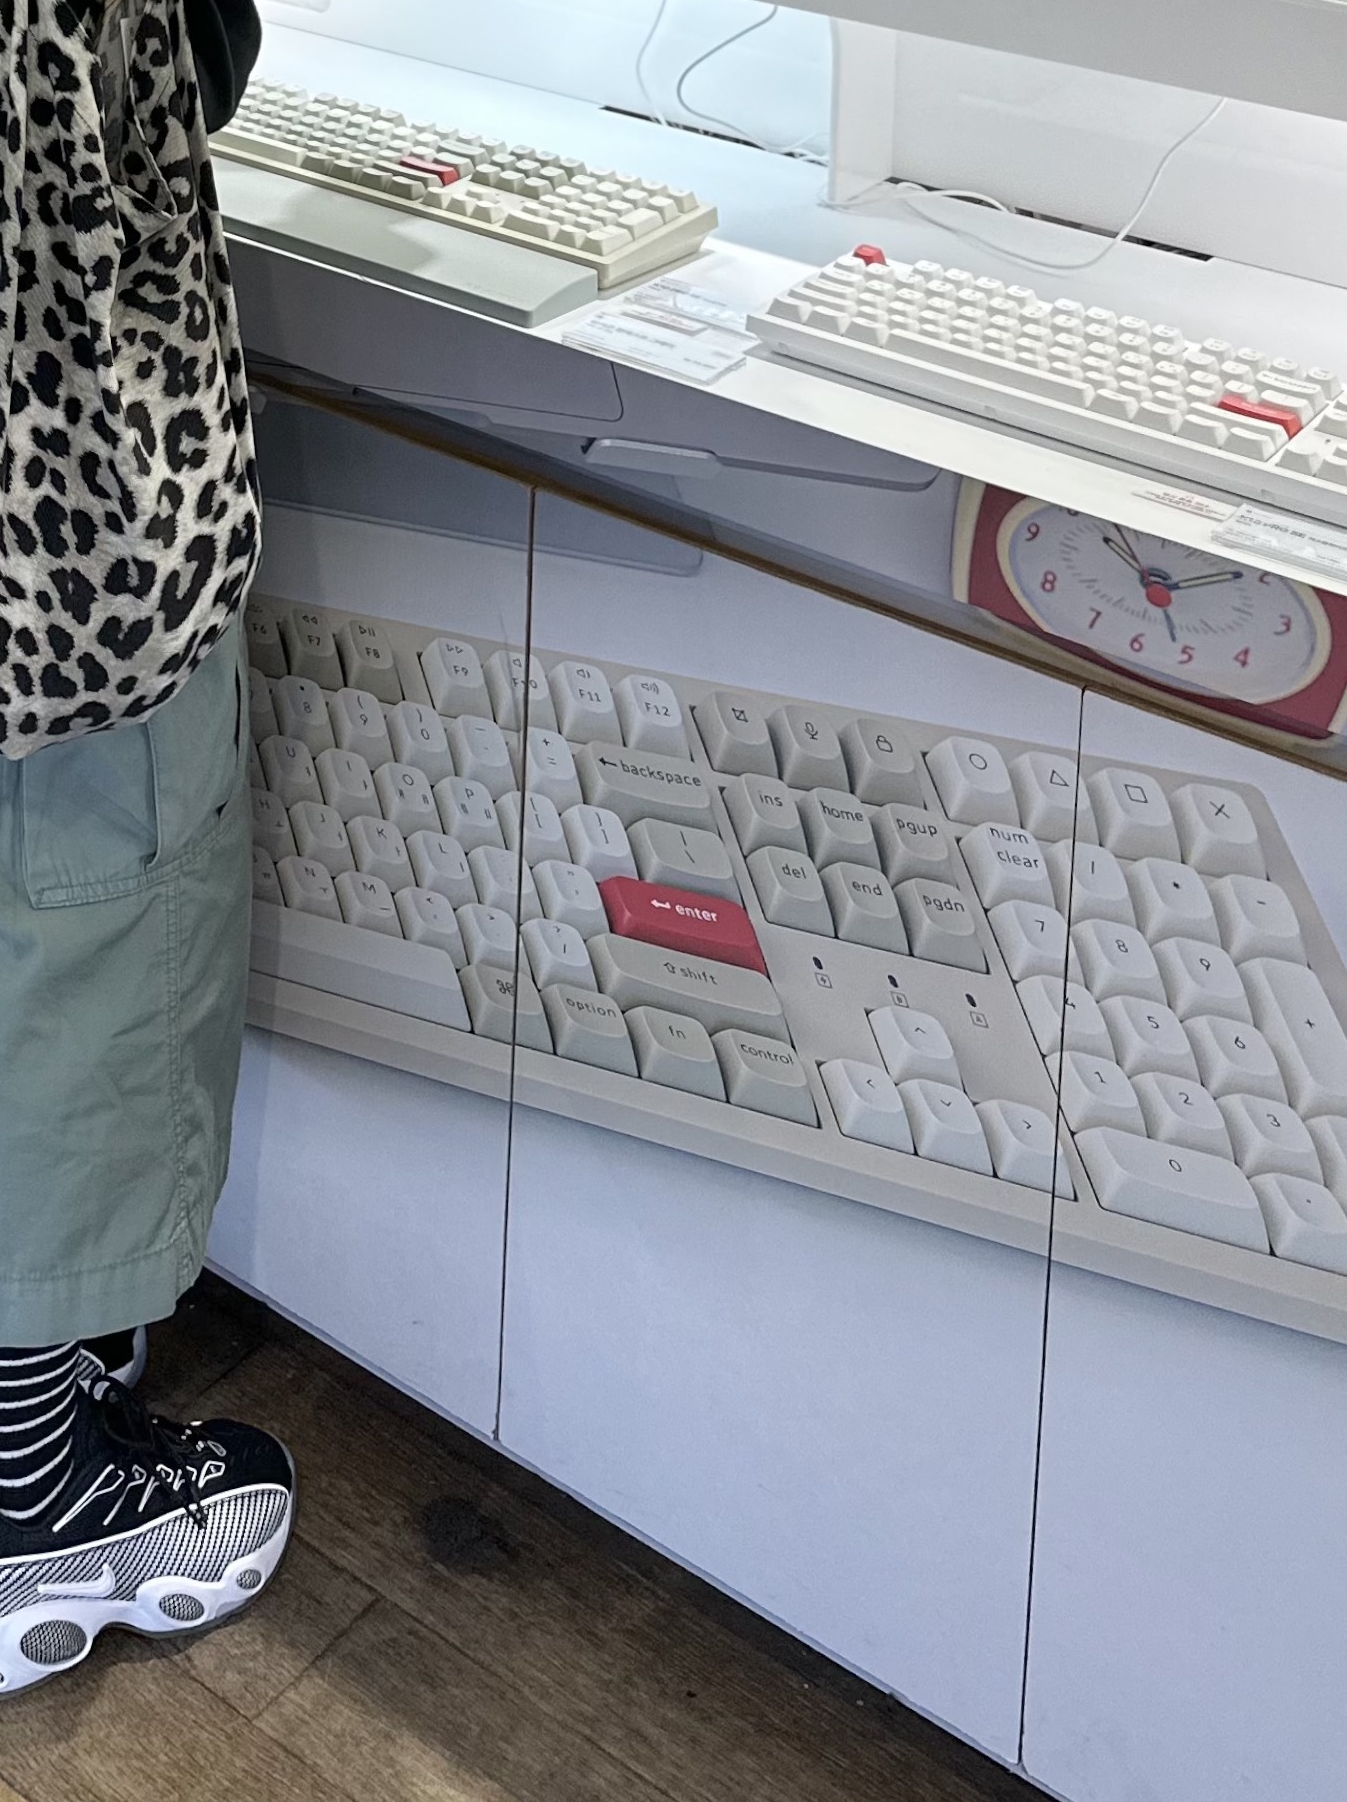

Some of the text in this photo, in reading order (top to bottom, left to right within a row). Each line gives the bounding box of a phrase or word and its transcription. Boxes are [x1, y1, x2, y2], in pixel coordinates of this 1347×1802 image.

[1025, 522, 1040, 542] 9
[1040, 570, 1058, 594] 8
[1088, 607, 1102, 630] 7
[1273, 614, 1292, 636] 3
[307, 634, 321, 647] F7
[1129, 633, 1145, 653] 6
[364, 646, 381, 659] F8
[1178, 644, 1195, 665] 5
[1233, 647, 1250, 669] 4
[452, 665, 469, 677] F9
[578, 688, 602, 703] F11
[644, 701, 671, 717] F12
[285, 746, 297, 759] U
[619, 758, 703, 787] backspace
[464, 787, 475, 800] P
[758, 792, 784, 808] ins
[819, 800, 865, 823] home
[376, 827, 387, 839] K
[896, 818, 938, 838] pgup
[988, 825, 1029, 844] num
[996, 850, 1039, 869] clear
[304, 866, 316, 878] N
[781, 863, 807, 880] del
[362, 882, 377, 894] M
[851, 881, 883, 896] end
[922, 894, 965, 912] pgdn
[675, 904, 717, 922] enter
[1035, 919, 1045, 933] 7
[1115, 939, 1129, 954] 8
[1199, 958, 1211, 972] 9
[679, 967, 718, 986] shift
[565, 997, 617, 1018] option
[1146, 1015, 1160, 1030] 5
[668, 1025, 686, 1039] fn
[1234, 1036, 1246, 1050] 6
[740, 1041, 795, 1066] control
[1094, 1071, 1107, 1084] 1
[1178, 1092, 1193, 1106] 2
[1266, 1113, 1281, 1128] 3
